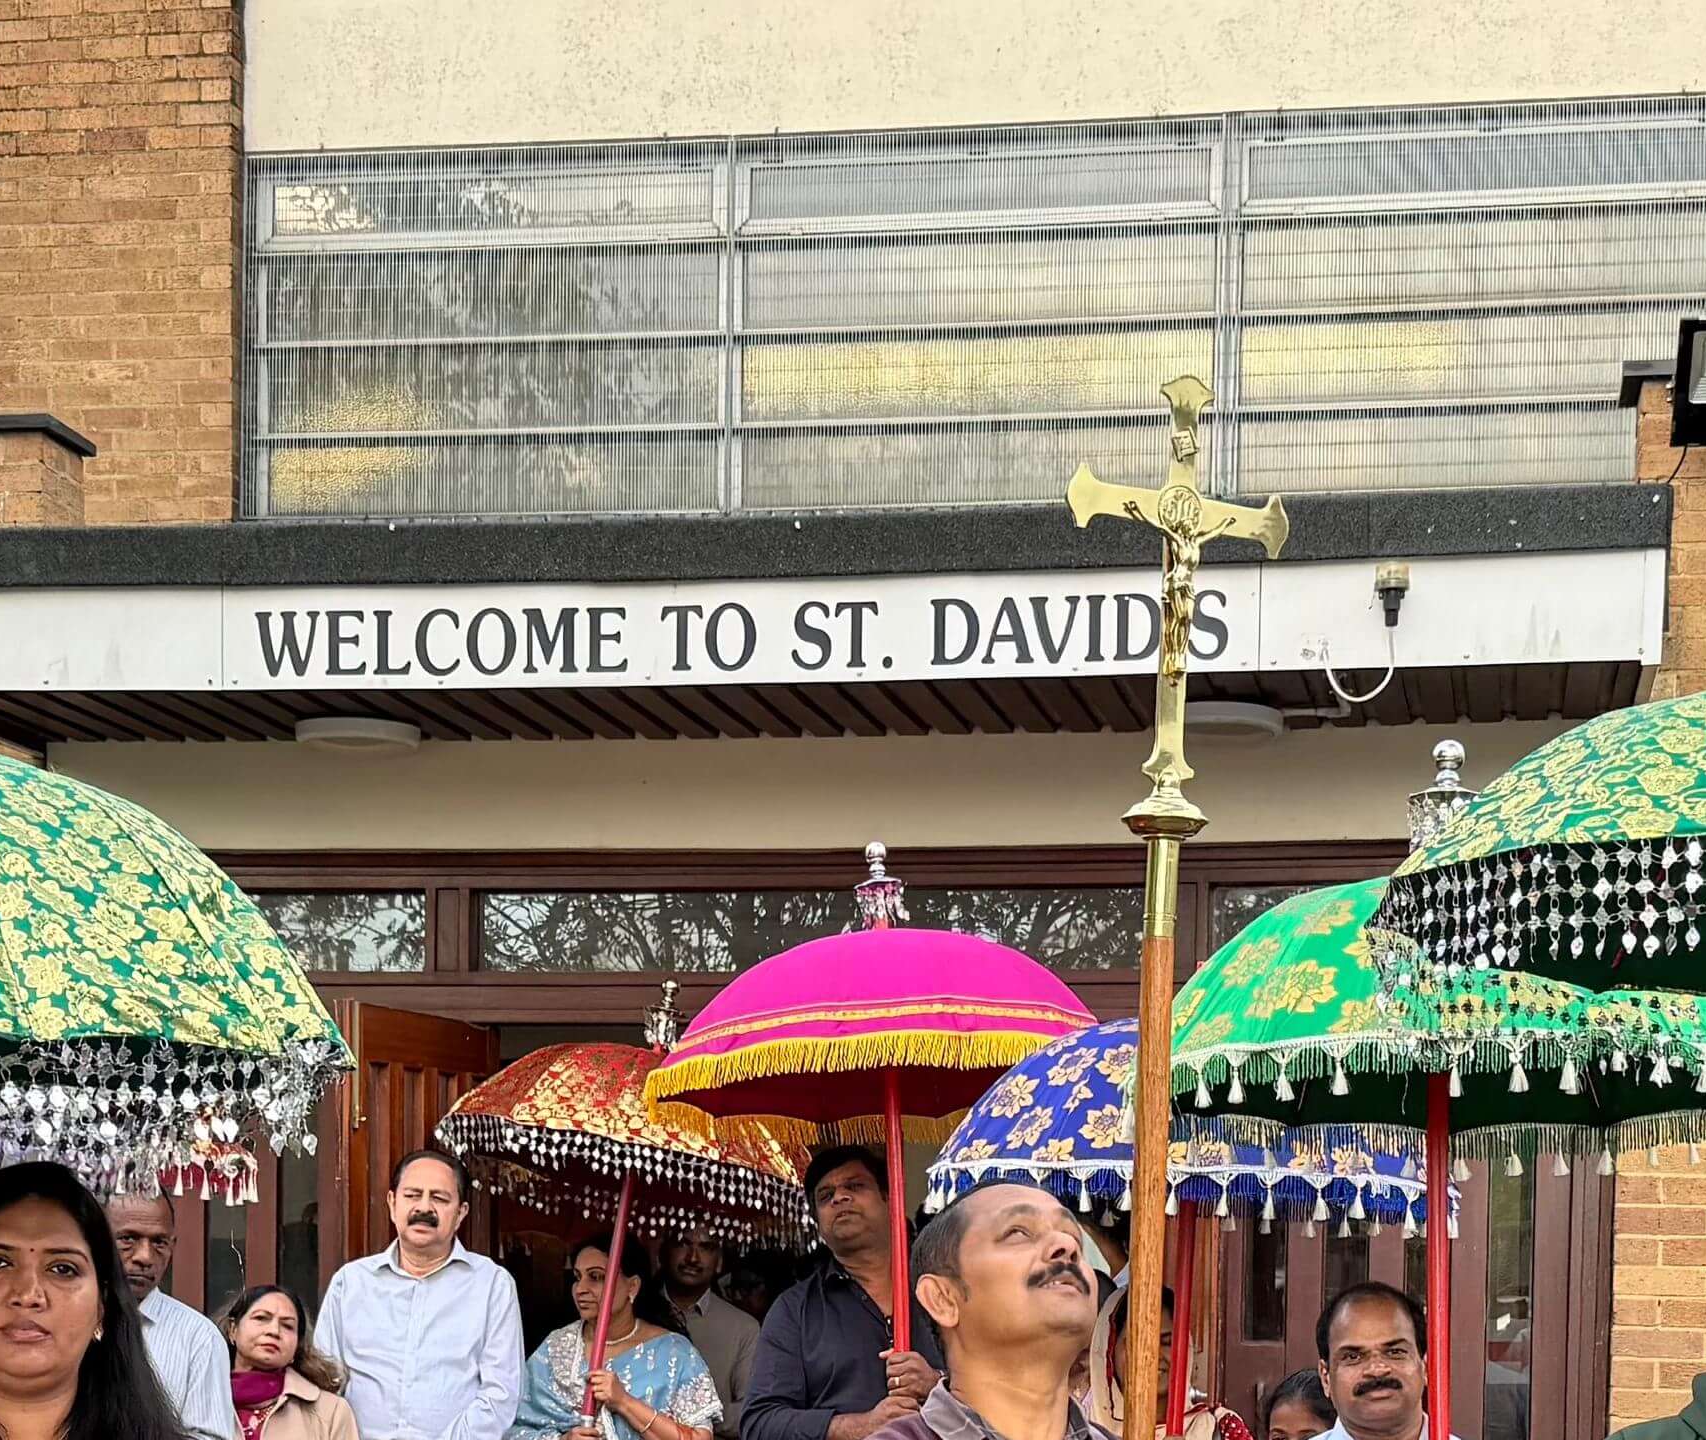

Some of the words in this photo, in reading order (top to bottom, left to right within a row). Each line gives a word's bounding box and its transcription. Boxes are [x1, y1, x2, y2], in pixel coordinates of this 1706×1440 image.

[254, 606, 629, 678] WELCOME
[660, 602, 757, 672] TO
[791, 600, 894, 671] ST.
[930, 589, 1229, 666] DAVIDS
